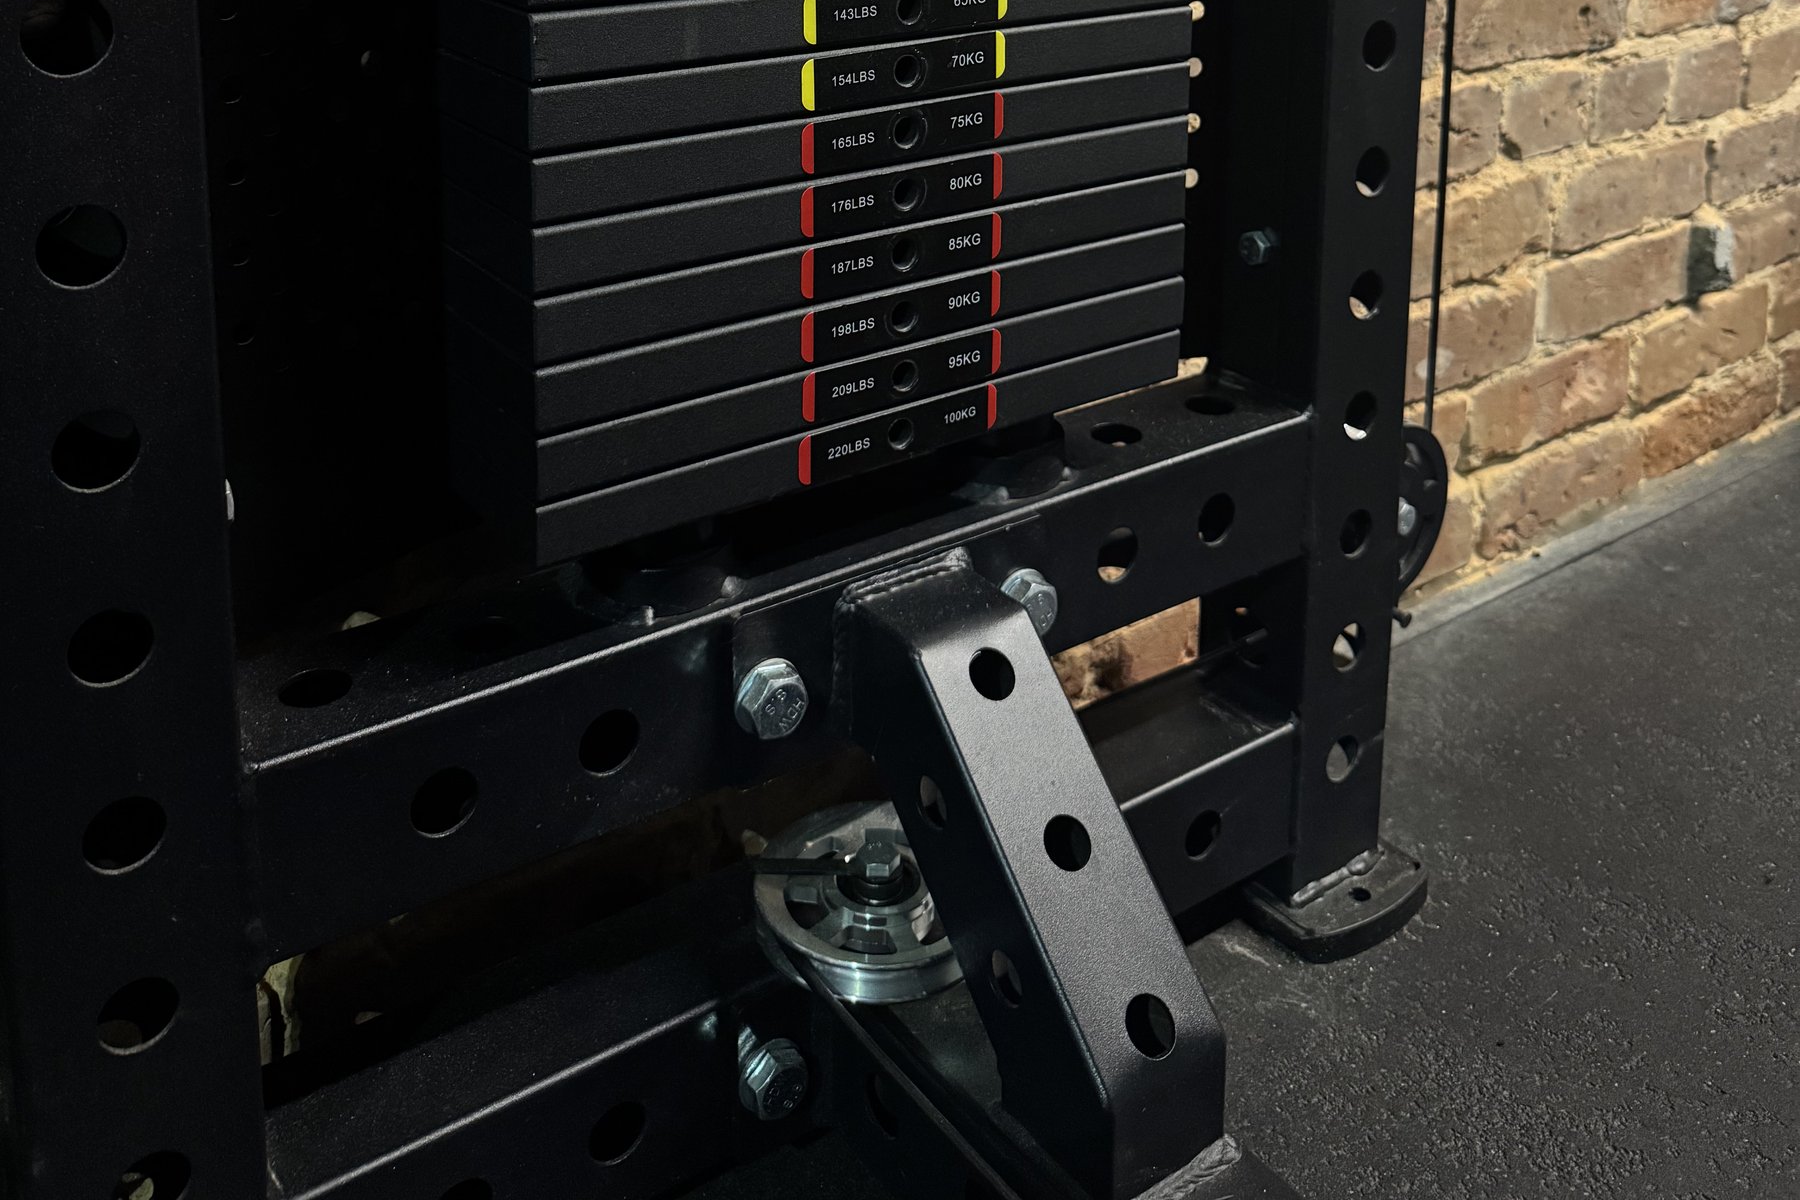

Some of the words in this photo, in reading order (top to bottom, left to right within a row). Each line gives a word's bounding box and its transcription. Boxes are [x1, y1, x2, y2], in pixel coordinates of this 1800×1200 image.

[833, 5, 878, 21] 143LBS
[951, 51, 984, 68] 70KG
[831, 69, 876, 87] 154LBS
[950, 111, 983, 129] 75KG
[831, 131, 875, 150] 165LBS
[949, 173, 982, 191] 80KG
[831, 194, 875, 213] 176LBS
[948, 232, 981, 251] 85KG
[831, 255, 874, 275] 187LBS
[948, 291, 981, 310] 90KG
[831, 317, 875, 338] 198LBS
[948, 350, 981, 369] 95KG
[831, 377, 875, 398] 209LBS
[944, 406, 977, 424] 100KG
[827, 437, 871, 460] 220LBS
